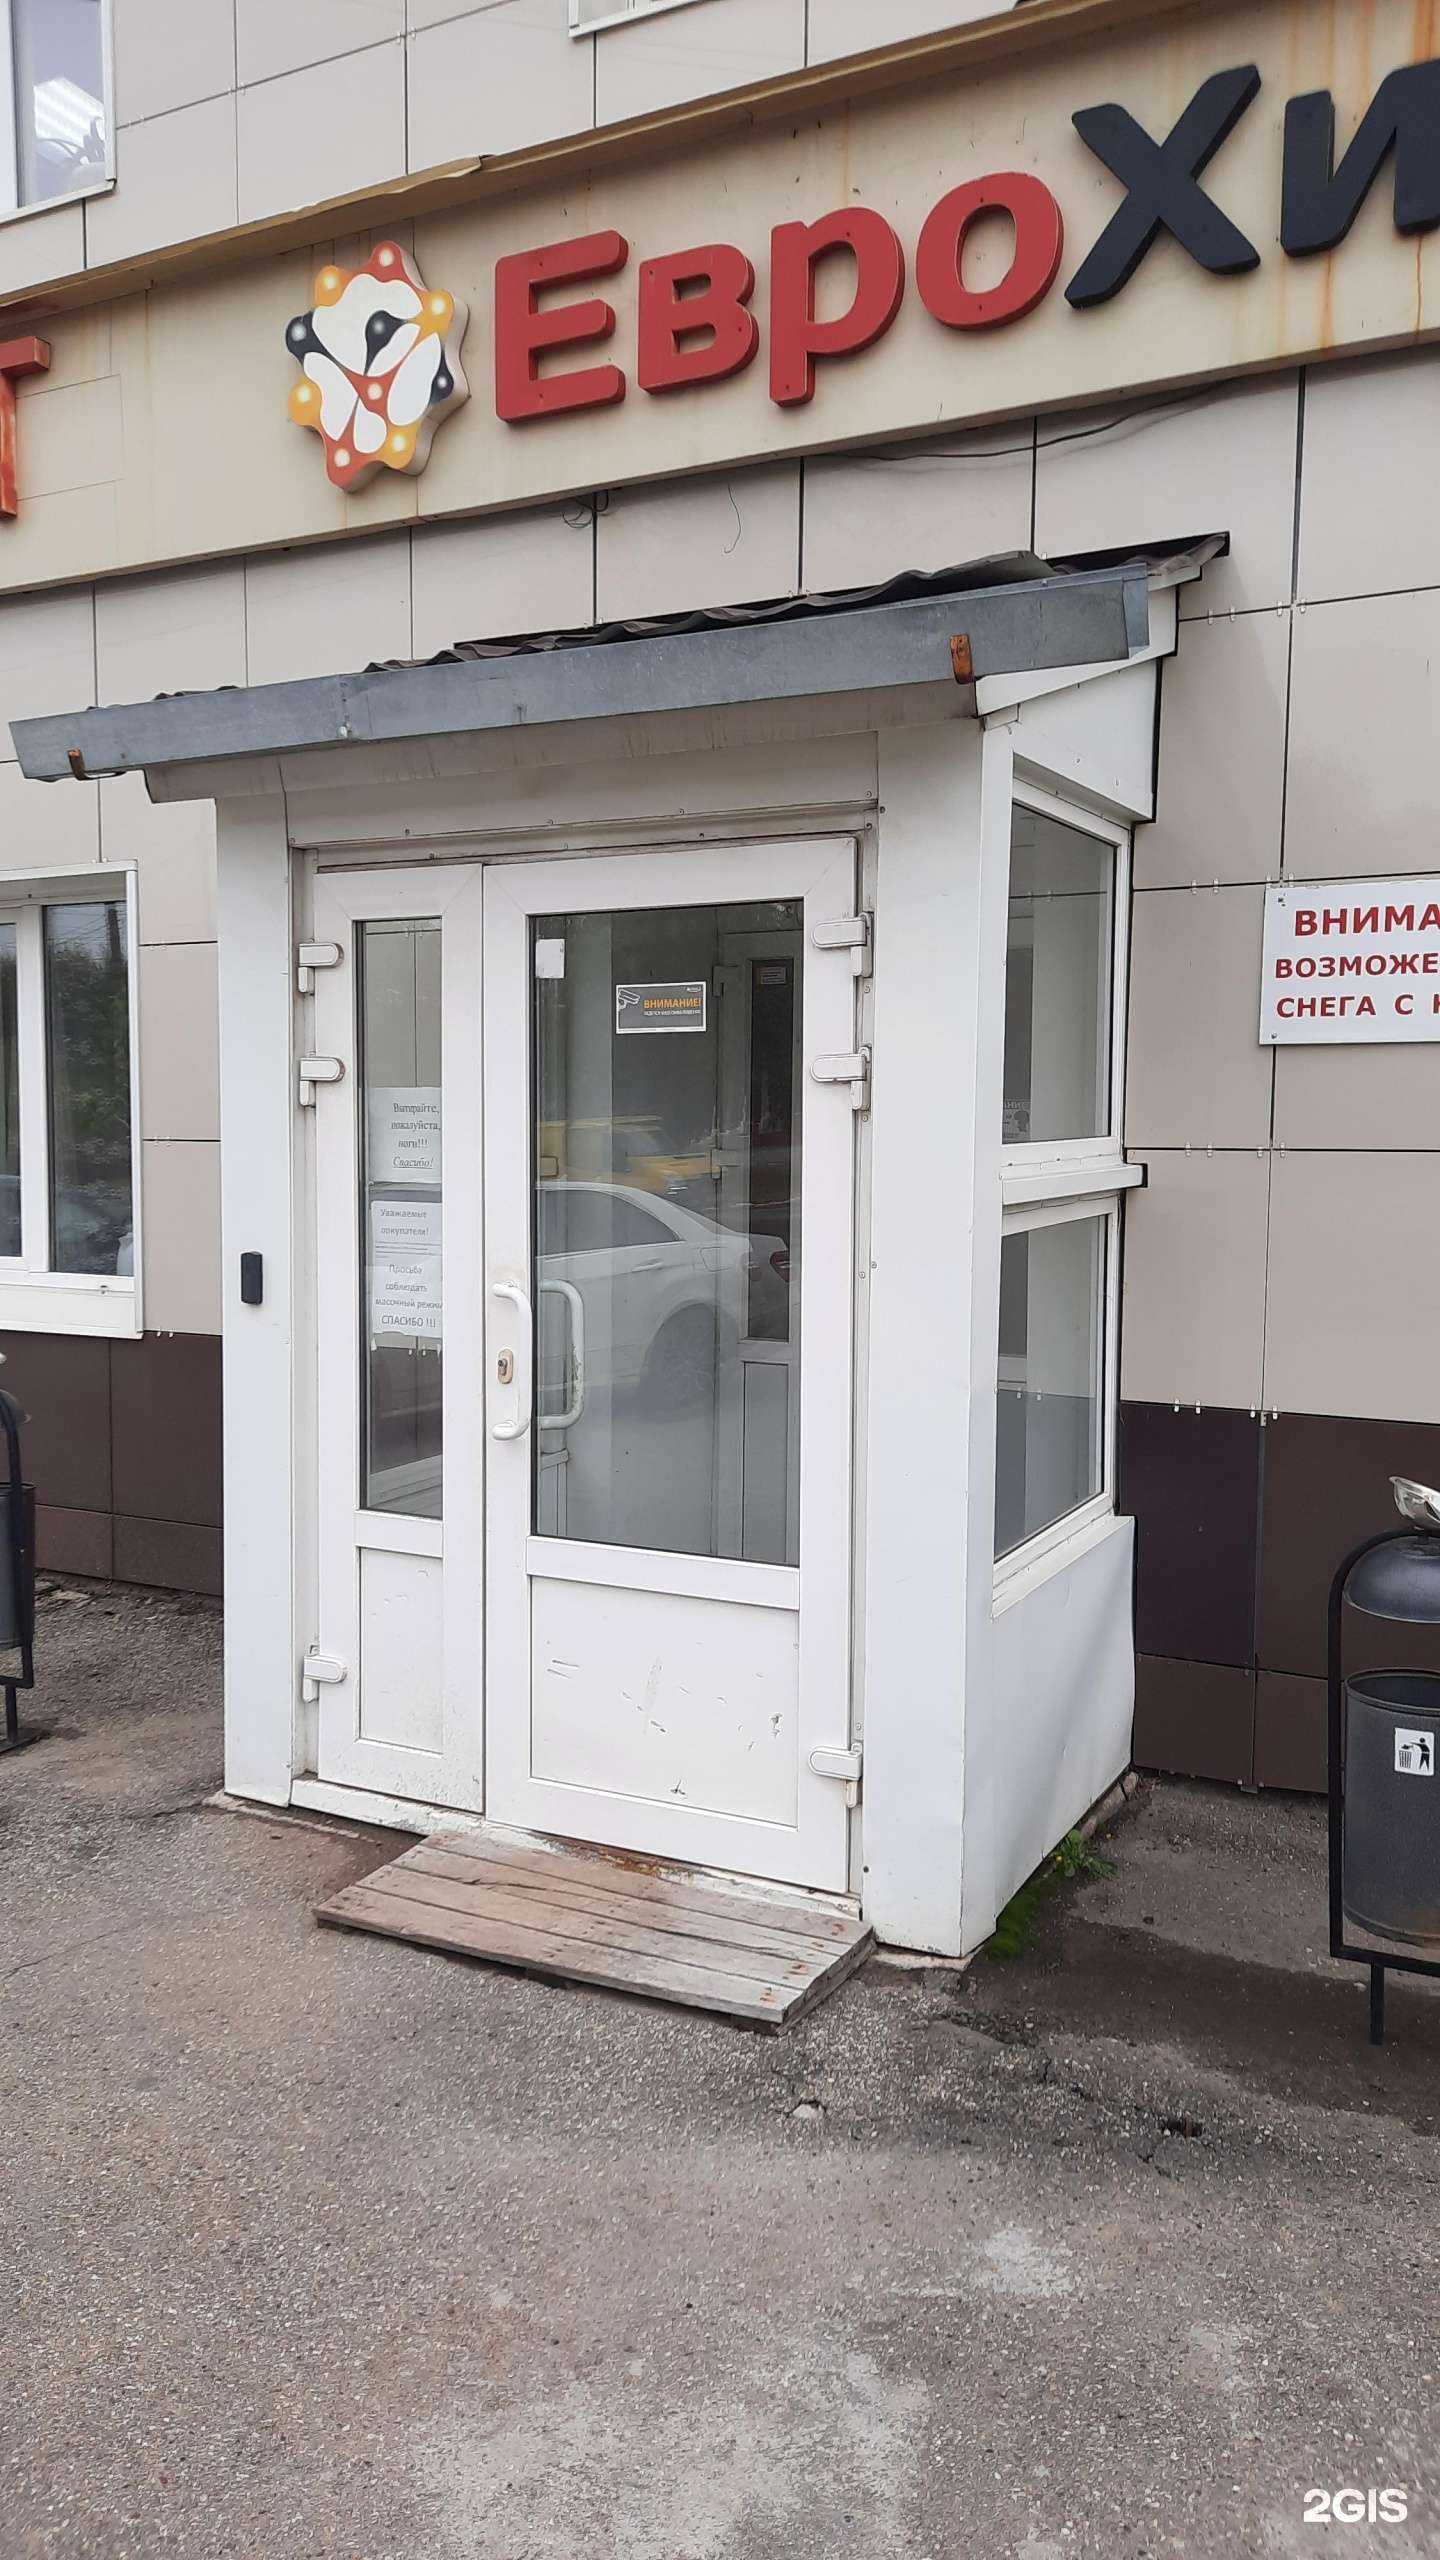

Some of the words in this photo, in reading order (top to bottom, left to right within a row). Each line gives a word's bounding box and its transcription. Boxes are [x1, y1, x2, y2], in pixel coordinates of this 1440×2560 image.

[1294, 903, 1440, 937] ВНИМА
[1275, 952, 1439, 979] ВОЗМОЖЕ
[643, 998, 702, 1009] ВНИМАНИЕ!
[1276, 995, 1376, 1018] СНЕГА
[1394, 994, 1414, 1015] С
[381, 1315, 424, 1327] СПАСИБО
